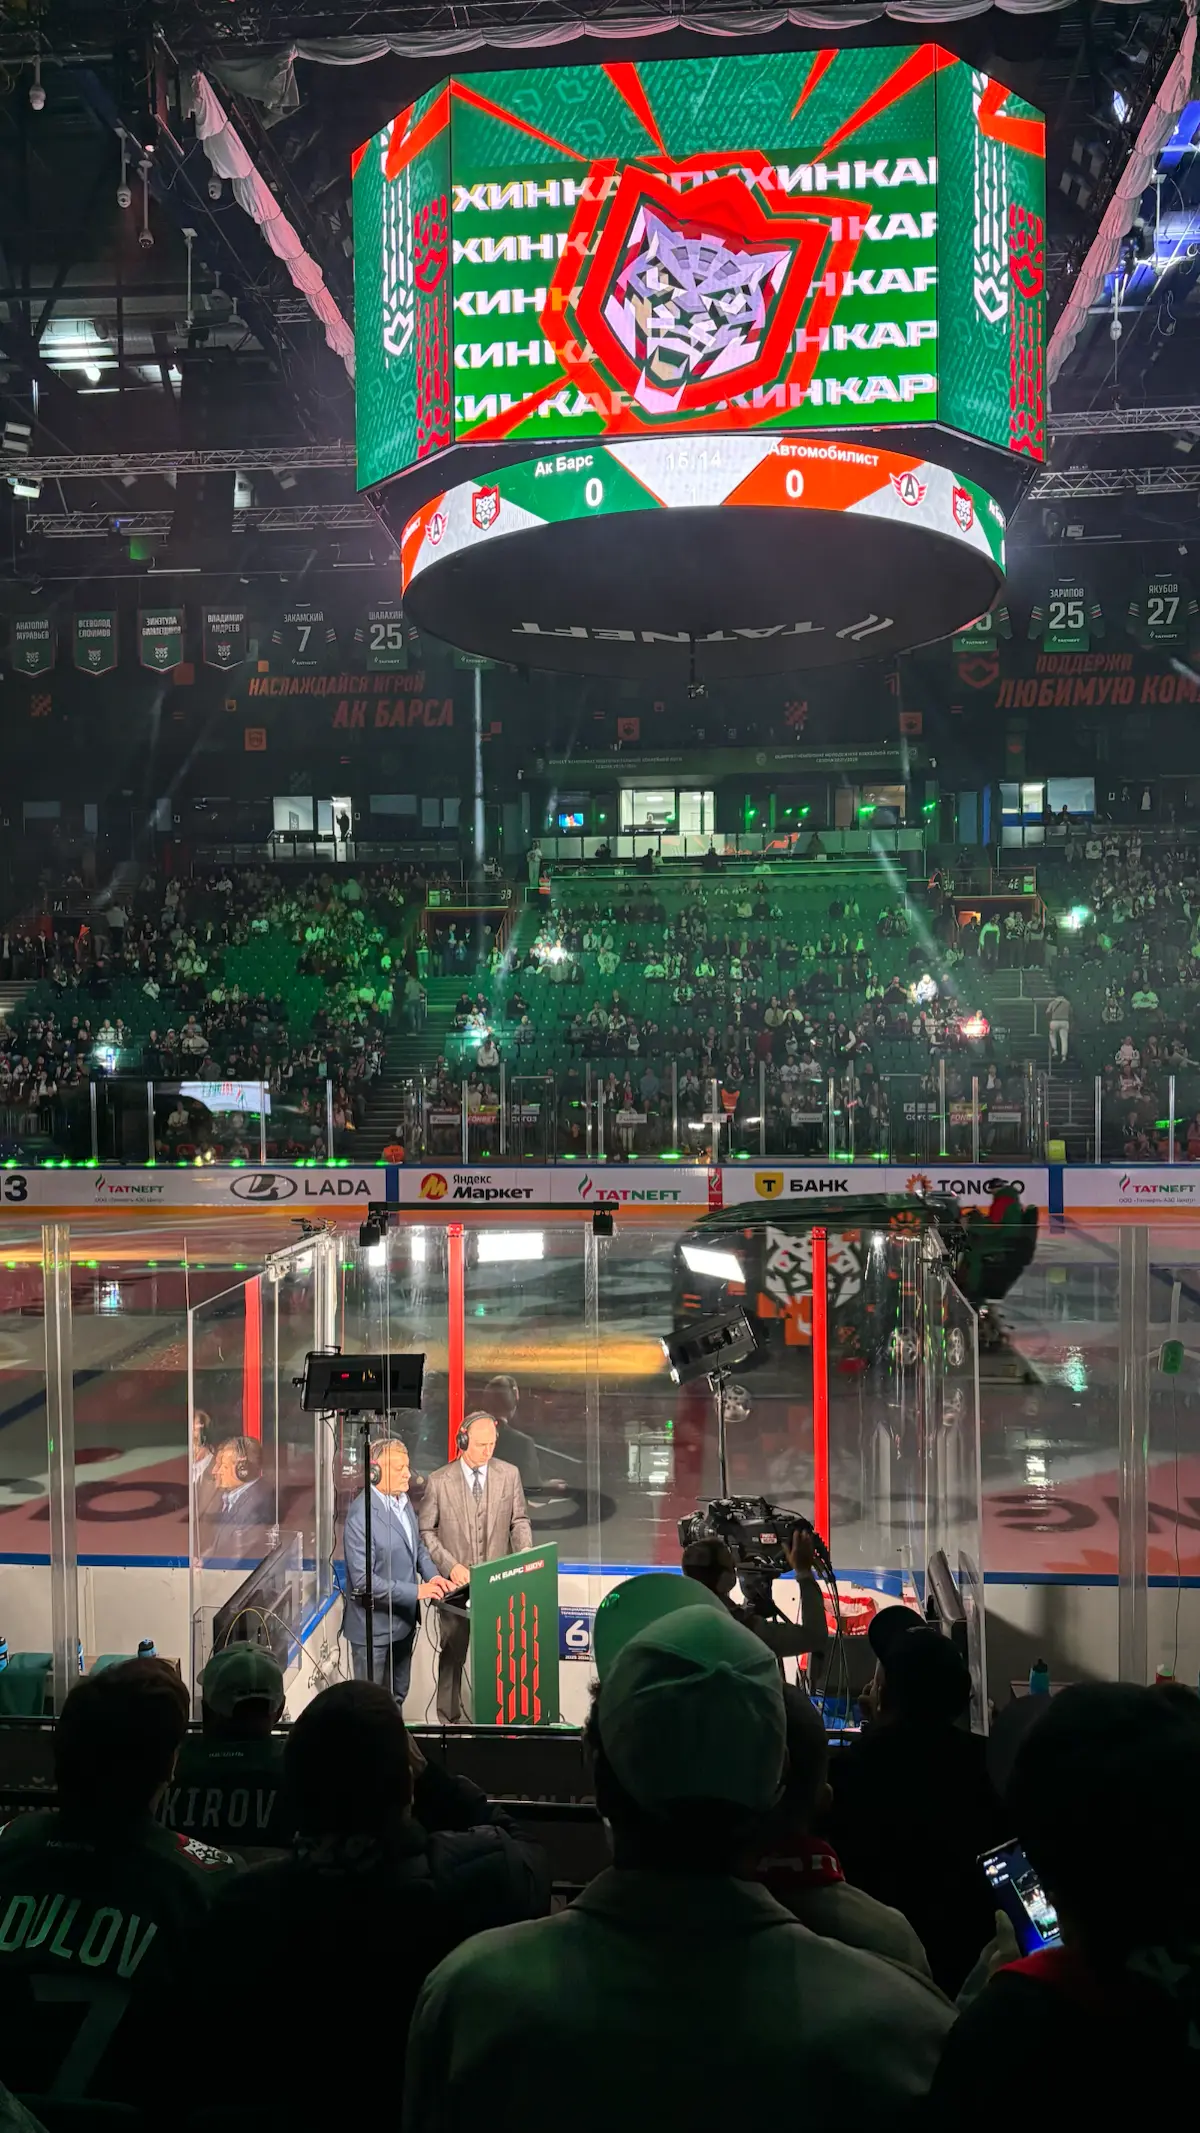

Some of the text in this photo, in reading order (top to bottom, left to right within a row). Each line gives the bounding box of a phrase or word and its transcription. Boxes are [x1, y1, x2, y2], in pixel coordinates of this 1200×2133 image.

[534, 454, 594, 477] Ак Барс
[768, 442, 880, 467] Автомобилист
[585, 478, 603, 507] 0
[785, 469, 805, 499] 0
[1049, 588, 1084, 598] ЗАРИПОВ
[1148, 584, 1179, 594] ЯКУБОВ
[207, 614, 244, 624] ВЛАДИМИР
[283, 611, 324, 623] ЗАКАМСКИЙ
[1049, 601, 1084, 629] 25
[1147, 597, 1180, 625] 27
[16, 620, 49, 630] АНАТОЛИЙ
[78, 619, 111, 628] ВСЕВОЛОД
[211, 623, 241, 633] АНДРЕЕВ
[511, 621, 826, 643] TATNEFT
[297, 625, 312, 652] 7
[370, 623, 403, 650] 25
[1035, 653, 1133, 675] ПОДДЕРЖИ
[249, 670, 426, 696] НАСЛАЖДАЙСЯ ИГРОЙ
[995, 674, 1200, 708] ЛЮБИМУЮ КОМ
[332, 698, 454, 728] АК БАРСА
[0, 1175, 28, 1202] 3
[108, 1185, 165, 1193] TATNEFT
[305, 1180, 372, 1196] LADA
[453, 1174, 493, 1185] Яндекс
[790, 1179, 849, 1192] БАНК
[1132, 1184, 1196, 1193] TATNEFT
[453, 1187, 534, 1201] Маркет
[595, 1190, 682, 1201] TATNEFT
[489, 1560, 544, 1583] АК БАРС ШОУ
[565, 1619, 589, 1647] 6
[0, 1893, 158, 1979] DULOV
